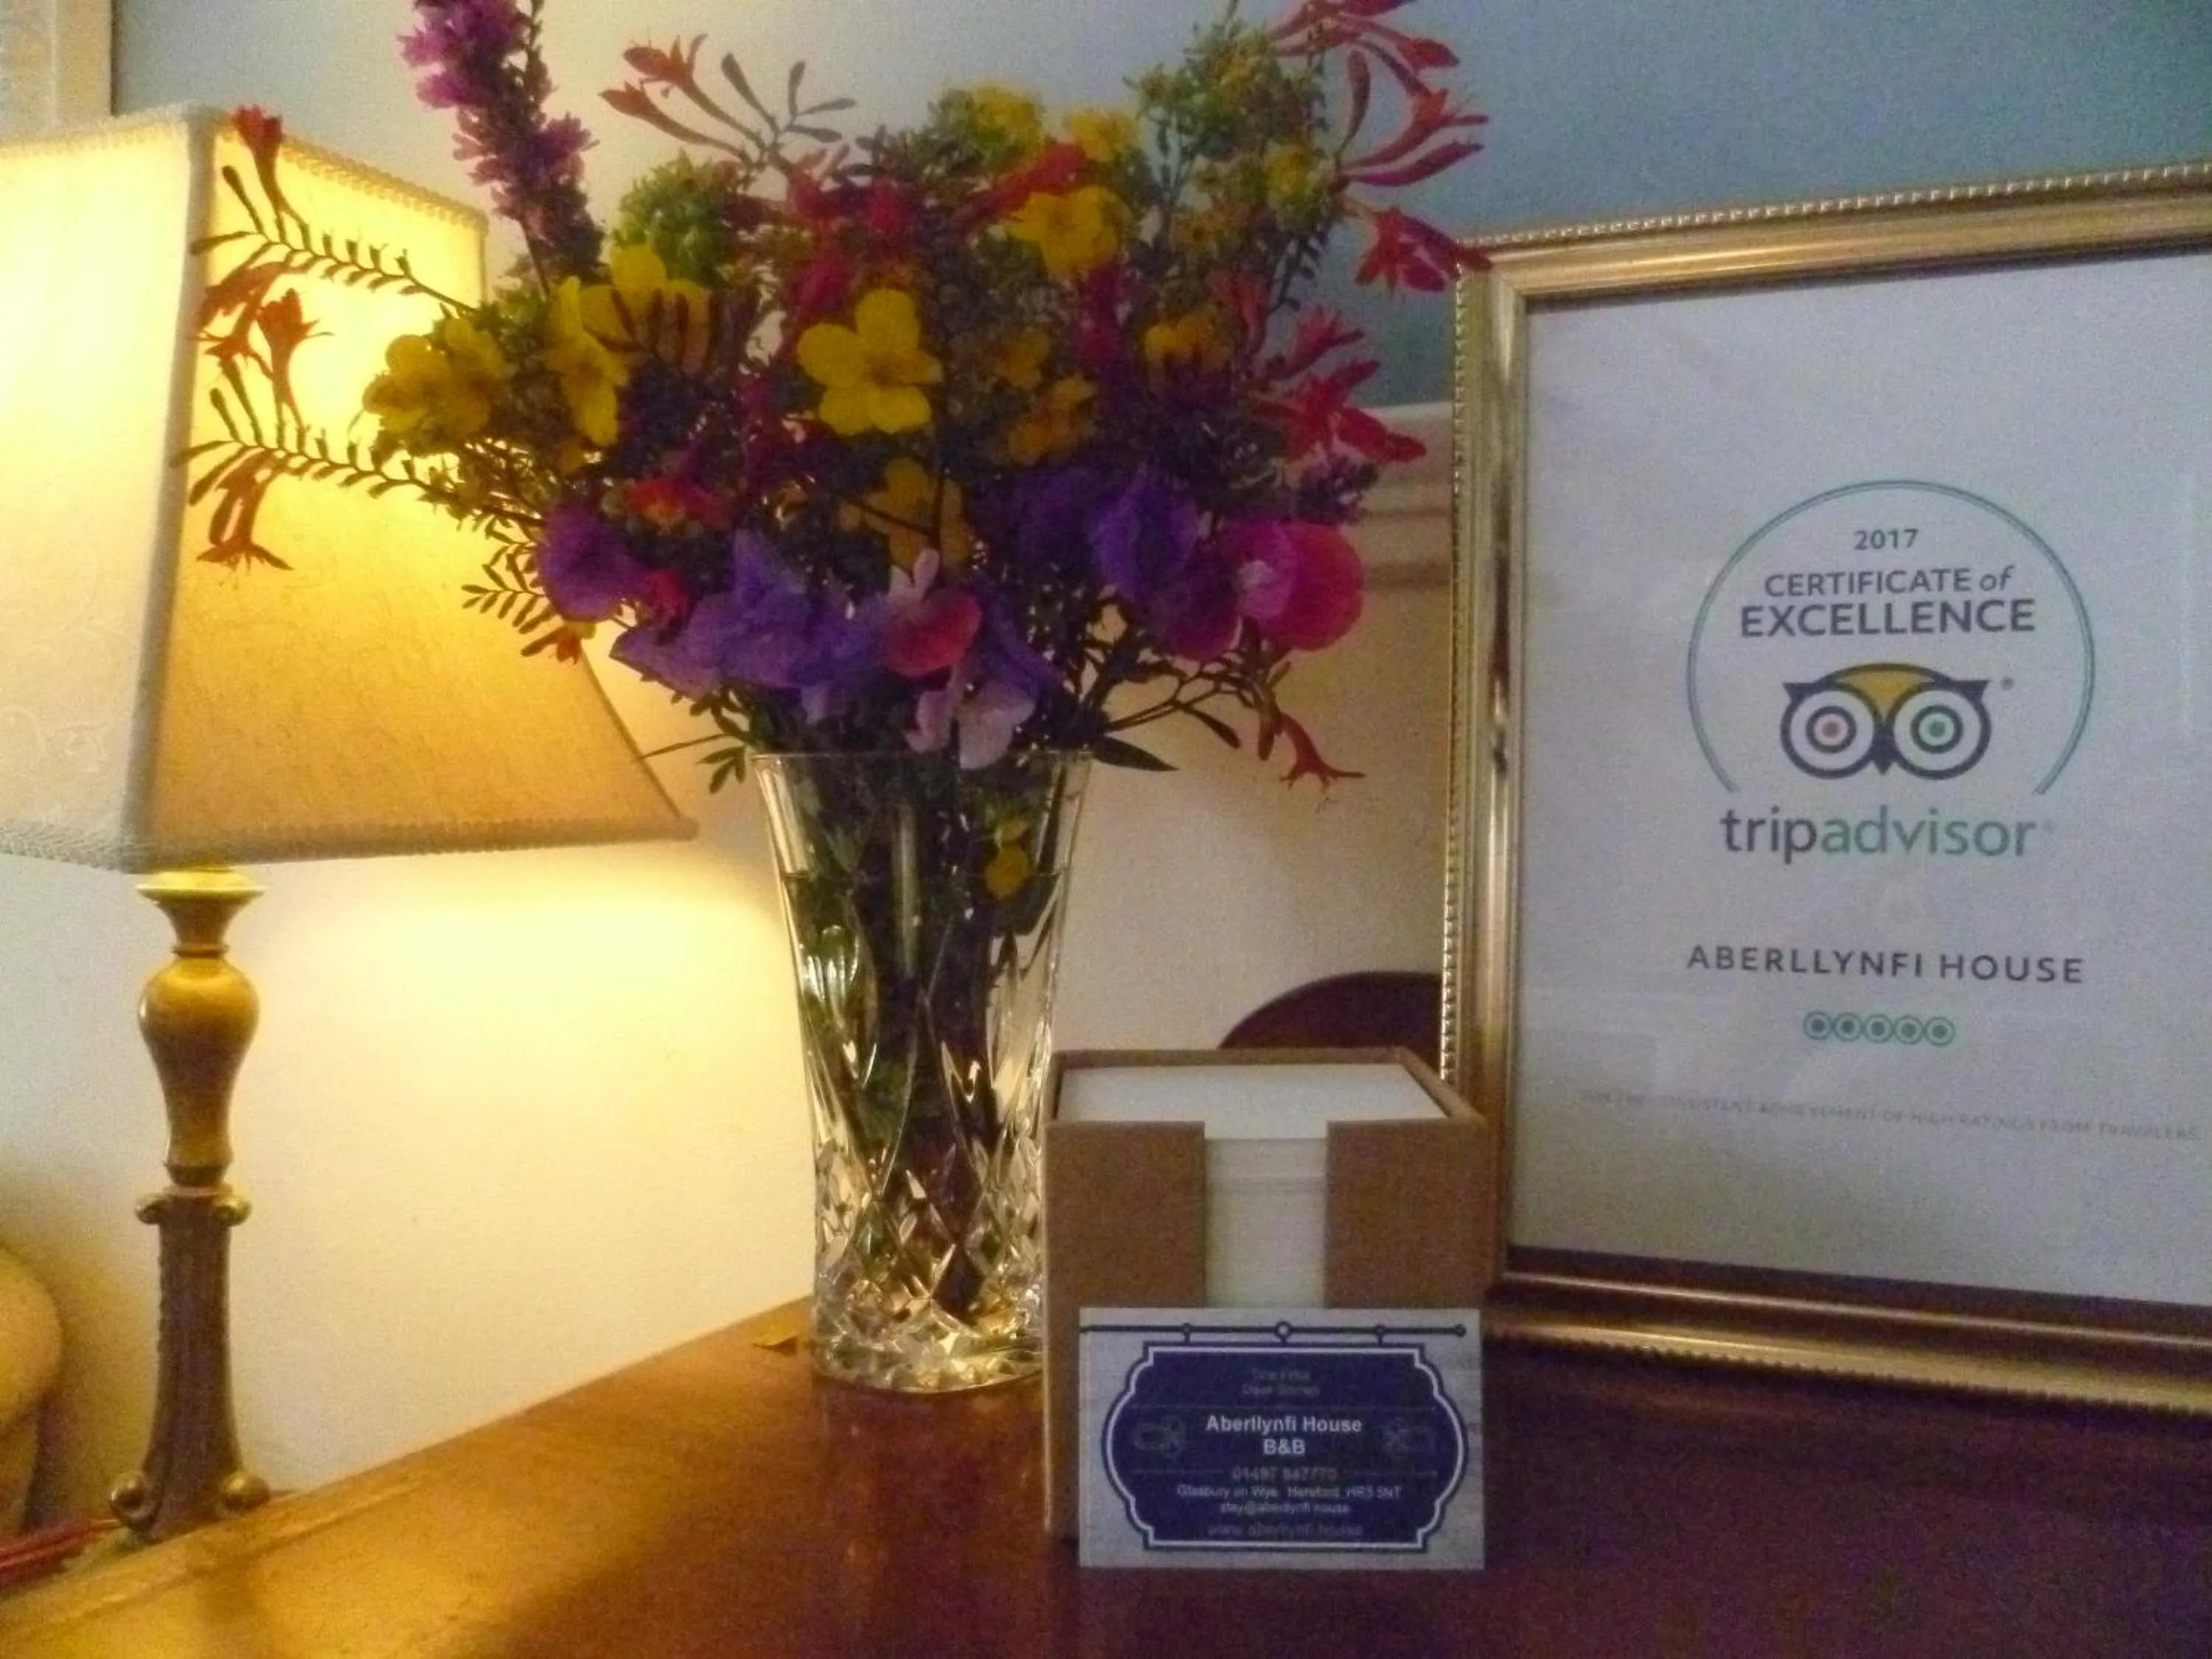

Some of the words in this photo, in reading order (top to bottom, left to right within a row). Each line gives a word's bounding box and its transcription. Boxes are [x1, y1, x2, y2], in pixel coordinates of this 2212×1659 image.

[1854, 528, 1919, 550] 2017
[1764, 567, 1971, 598] CERTIFICATE
[1979, 565, 2015, 591] of
[1740, 599, 2036, 637] EXCELLENCE
[1719, 804, 2037, 864] tripadvisor
[1687, 944, 1924, 979] ABERLLYNFI
[1939, 953, 2084, 984] HOUSE
[1206, 1415, 1298, 1435] Aberllynfi
[1302, 1416, 1363, 1432] House
[1263, 1439, 1306, 1455] B&B
